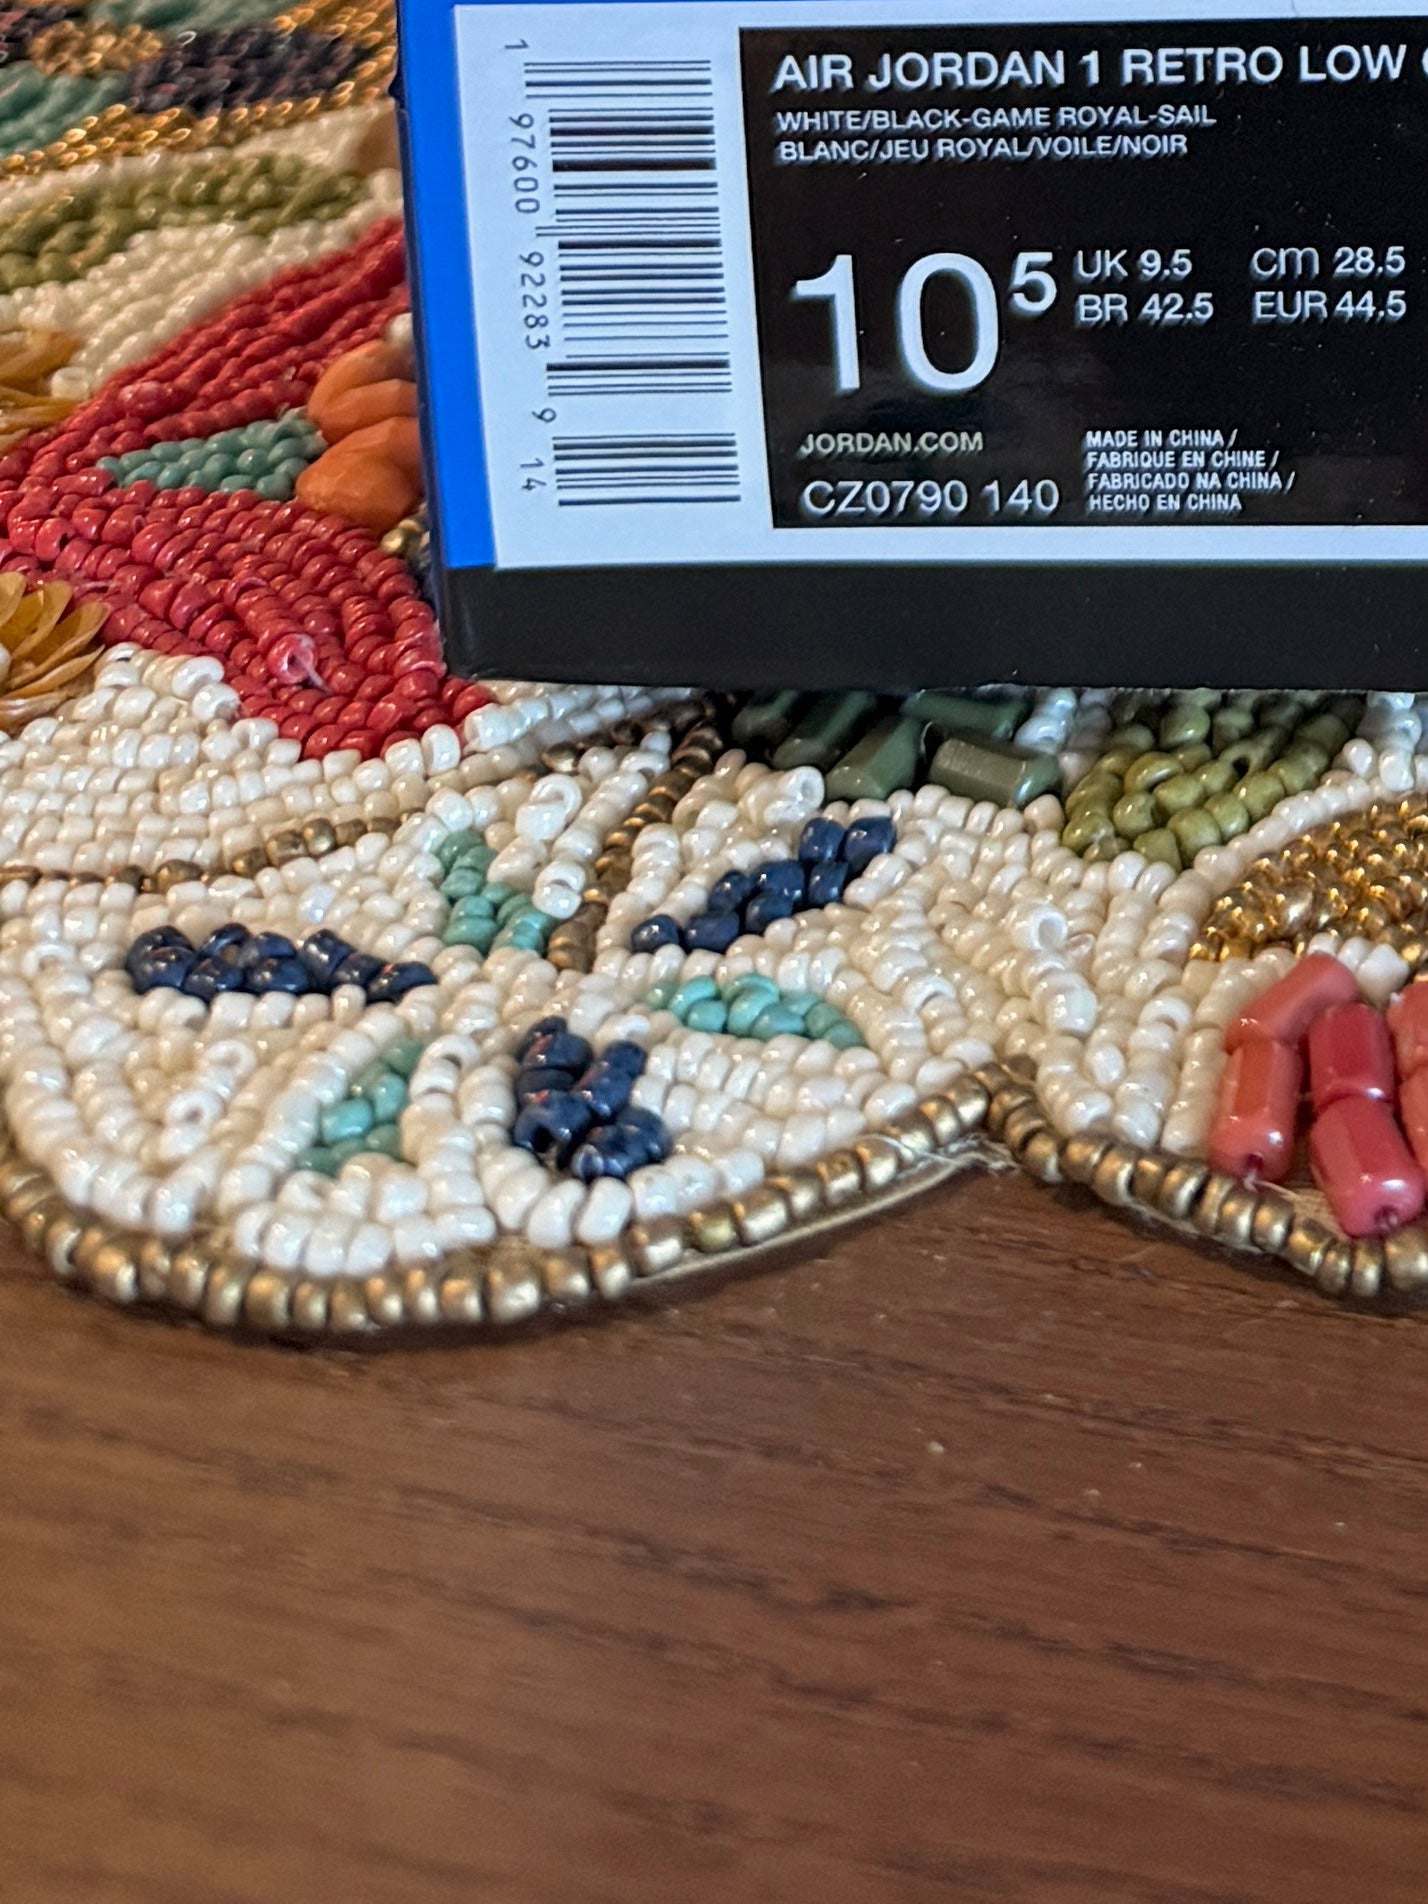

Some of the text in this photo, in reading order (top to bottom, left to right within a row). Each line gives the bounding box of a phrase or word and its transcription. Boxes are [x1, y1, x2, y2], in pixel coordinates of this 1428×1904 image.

[774, 54, 854, 90] AIR
[868, 50, 1065, 89] JORDAN
[1082, 50, 1099, 84] 1
[1123, 46, 1283, 83] RETRO
[1300, 44, 1407, 81] LOW
[777, 104, 1217, 132] WHITE/BLACK-GAME ROYAL-SAIL
[779, 134, 1188, 161] BLANC/JEU ROYAL/VOILE/NOIR
[508, 112, 541, 215] 97600
[1077, 249, 1192, 279] UK 9.5
[1335, 245, 1406, 274] 28.5
[518, 251, 551, 350] 92283
[1078, 292, 1214, 322] BR 42.5
[1255, 290, 1407, 319] EUR 44.5
[800, 431, 983, 455] JORDAN.COM
[1085, 430, 1138, 448] MADE
[1144, 430, 1163, 447] IN
[519, 457, 547, 492] 14
[1086, 450, 1175, 470] FABRIQUE
[1181, 450, 1205, 468] EN
[1088, 472, 1190, 491] FABRICADO
[1195, 471, 1222, 490] NA
[803, 479, 1059, 514] CZ0790 140
[1089, 493, 1242, 511] HECHO EN CHINA
